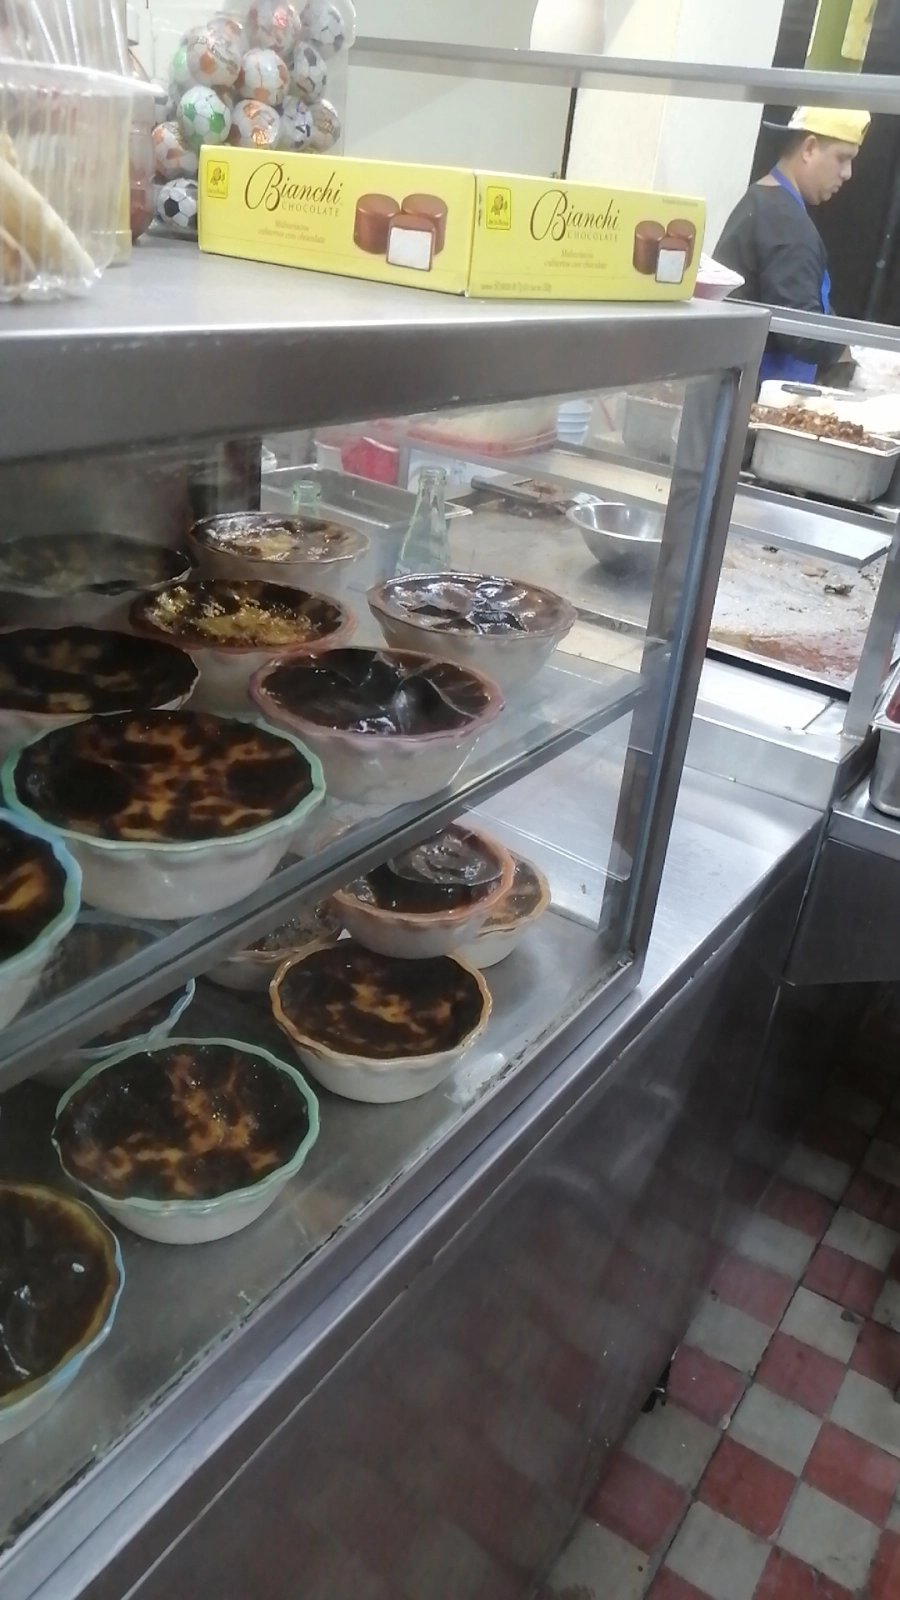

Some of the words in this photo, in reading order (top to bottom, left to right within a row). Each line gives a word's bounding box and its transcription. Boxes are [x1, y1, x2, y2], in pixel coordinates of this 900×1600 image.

[244, 161, 343, 212] Bianchi
[281, 201, 340, 218] CHOCOLATE
[530, 189, 621, 242] Bianchi
[567, 229, 618, 243] CHOCOLATE
